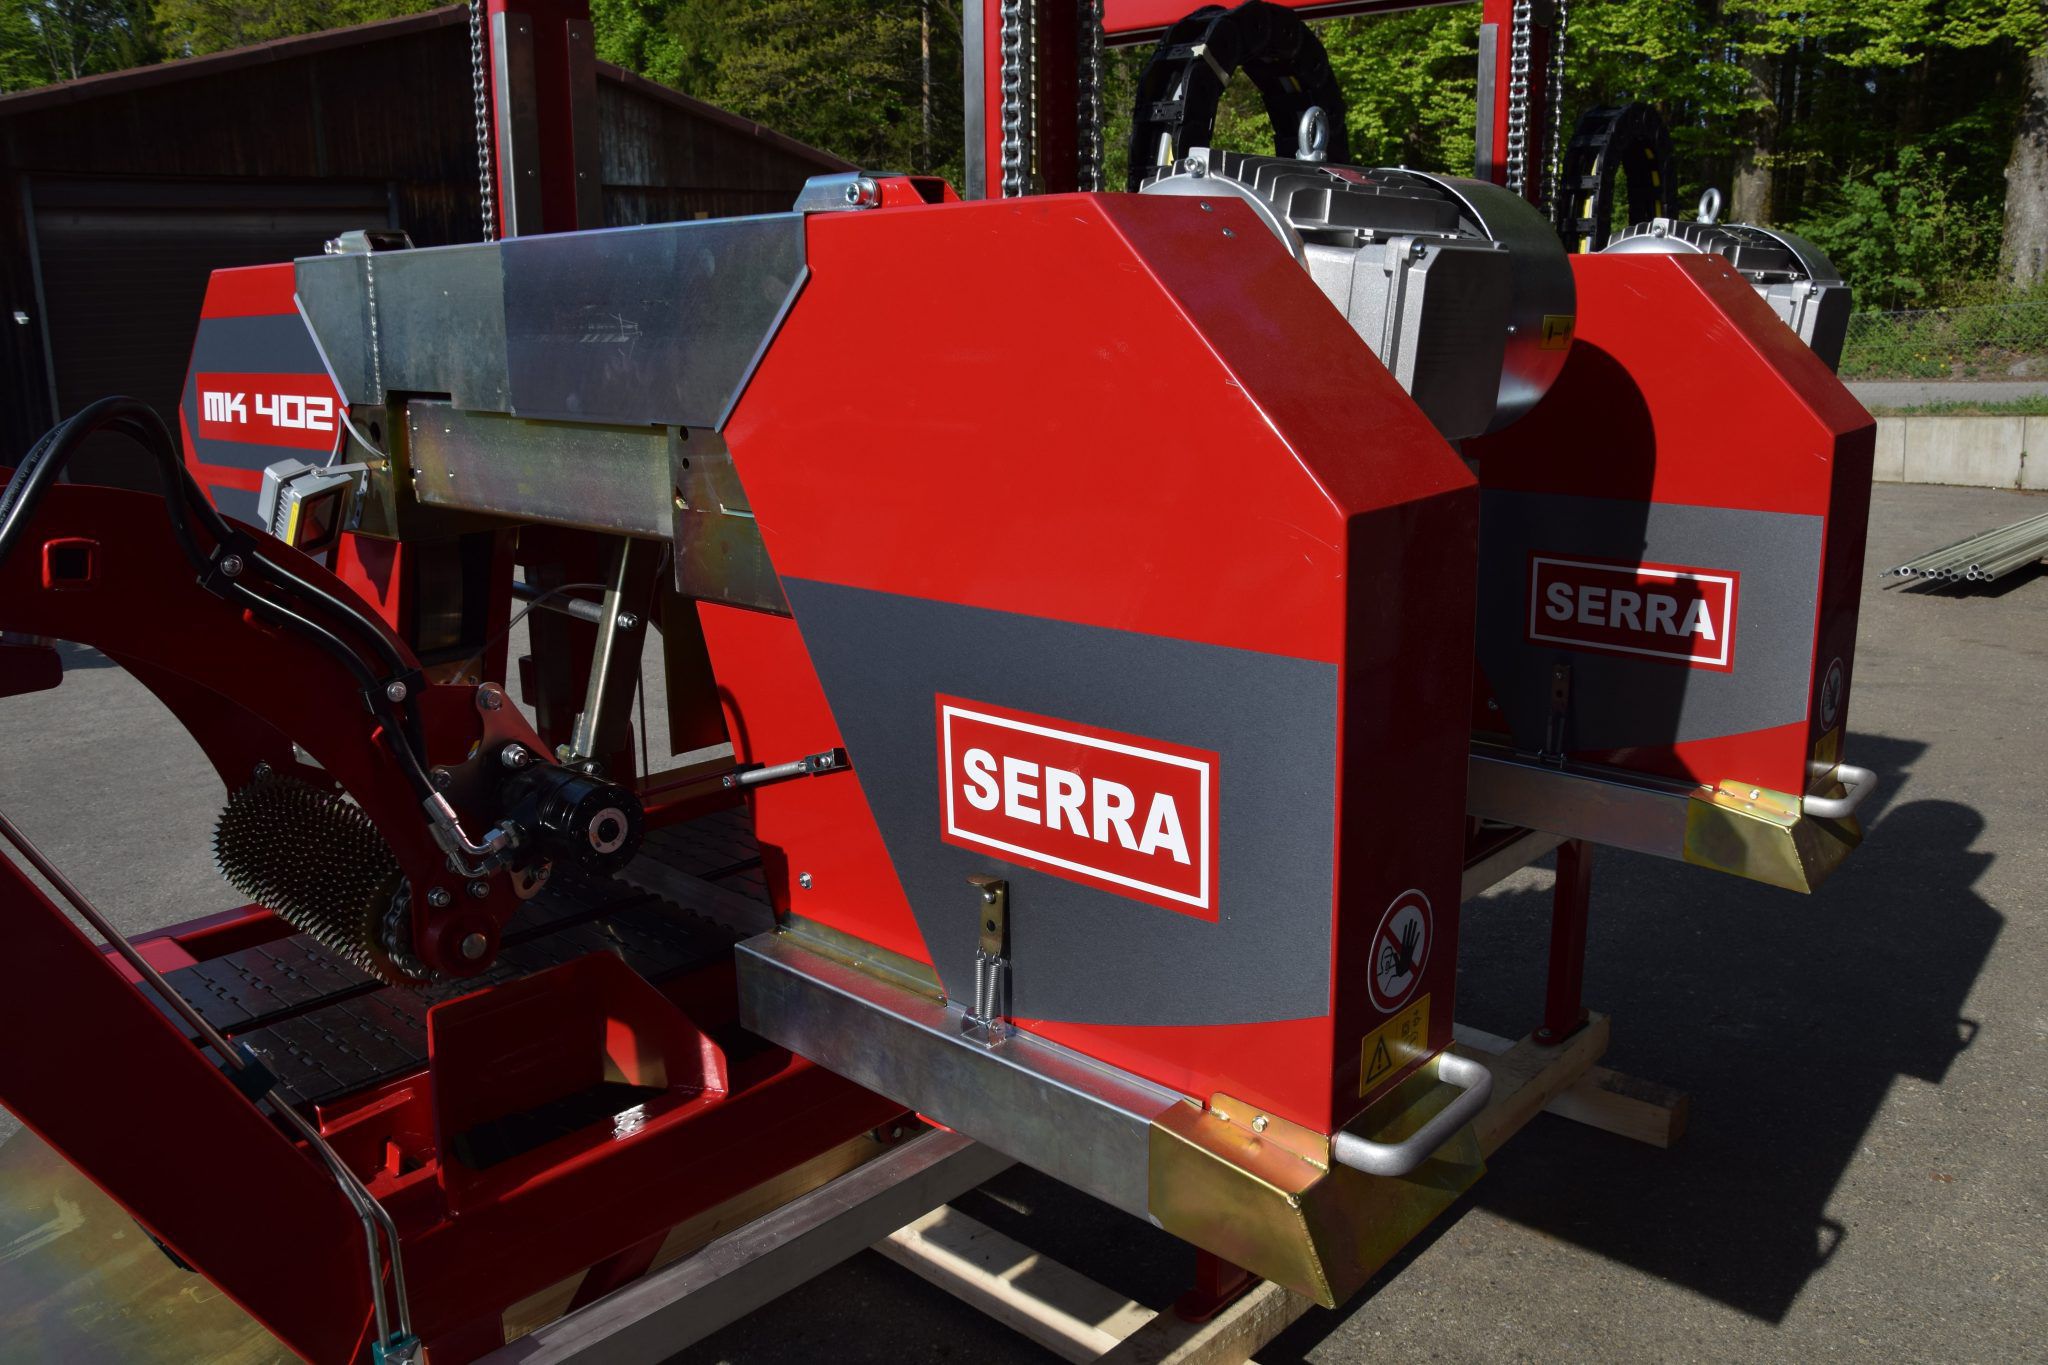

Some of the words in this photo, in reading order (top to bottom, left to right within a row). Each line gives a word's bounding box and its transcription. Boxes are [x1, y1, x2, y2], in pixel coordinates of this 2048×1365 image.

[255, 393, 333, 431] 402
[1545, 582, 1716, 641] SERRA
[963, 748, 1191, 866] SERRA
